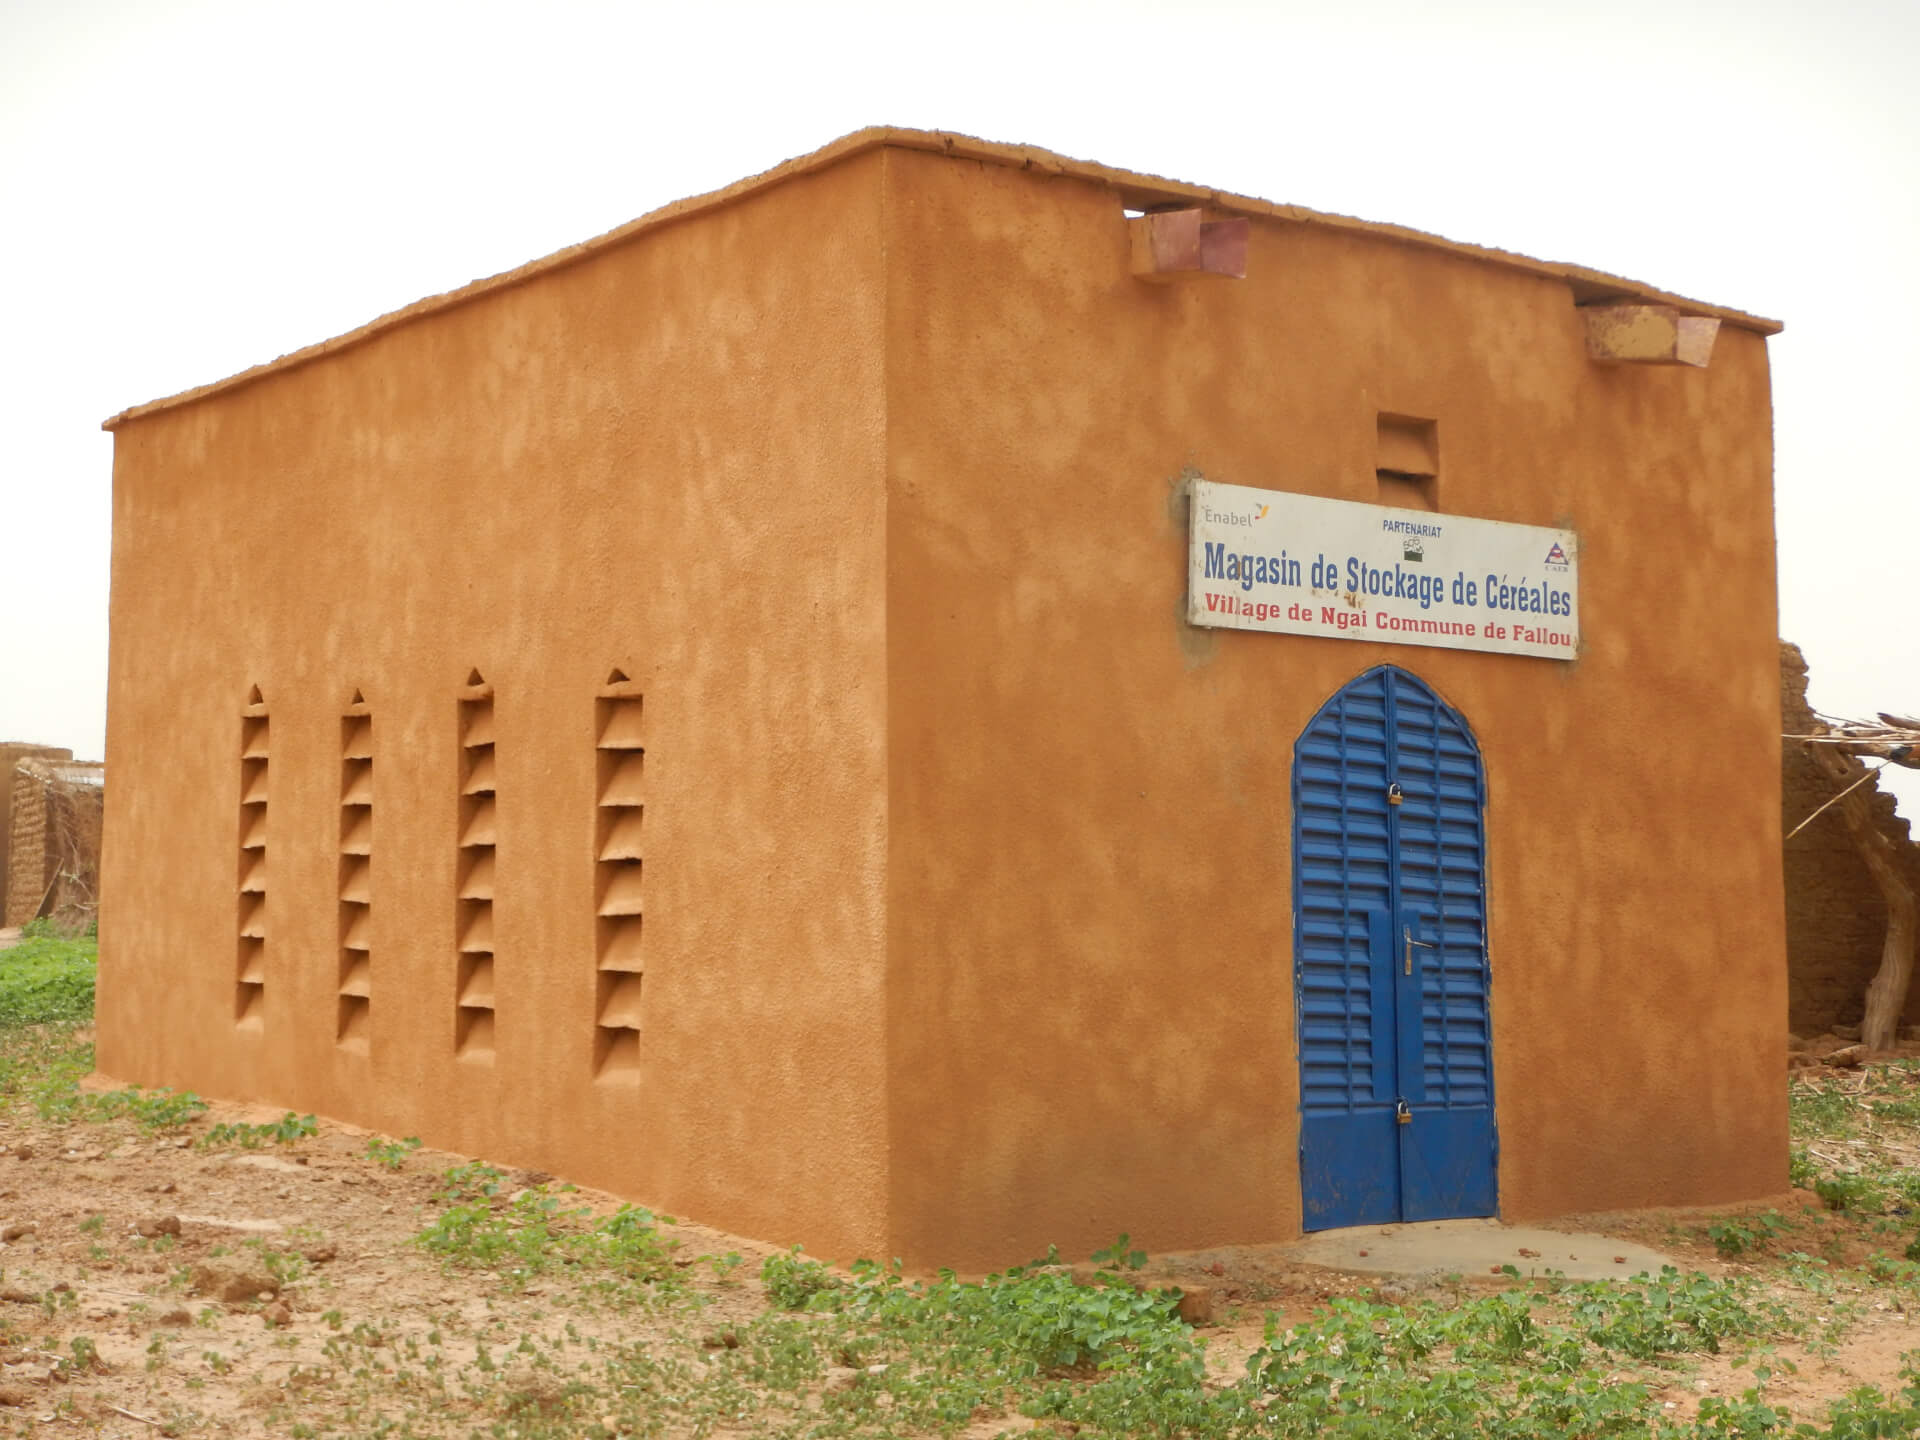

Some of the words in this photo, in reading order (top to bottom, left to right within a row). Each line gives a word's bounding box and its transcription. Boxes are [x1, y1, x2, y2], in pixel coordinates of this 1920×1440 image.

[1205, 508, 1252, 527] Enabel
[1383, 520, 1442, 538] PARTENARIAT
[1204, 542, 1301, 591] Magasin
[1311, 553, 1338, 590] de
[1347, 557, 1443, 609] Stockage
[1452, 572, 1477, 606] de
[1486, 574, 1571, 616] Céréales
[1205, 592, 1280, 621] Village
[1288, 603, 1312, 622] de
[1321, 607, 1367, 630] Ngai
[1376, 612, 1476, 636] Commune
[1484, 622, 1506, 640] de
[1513, 625, 1571, 646] Fallou
